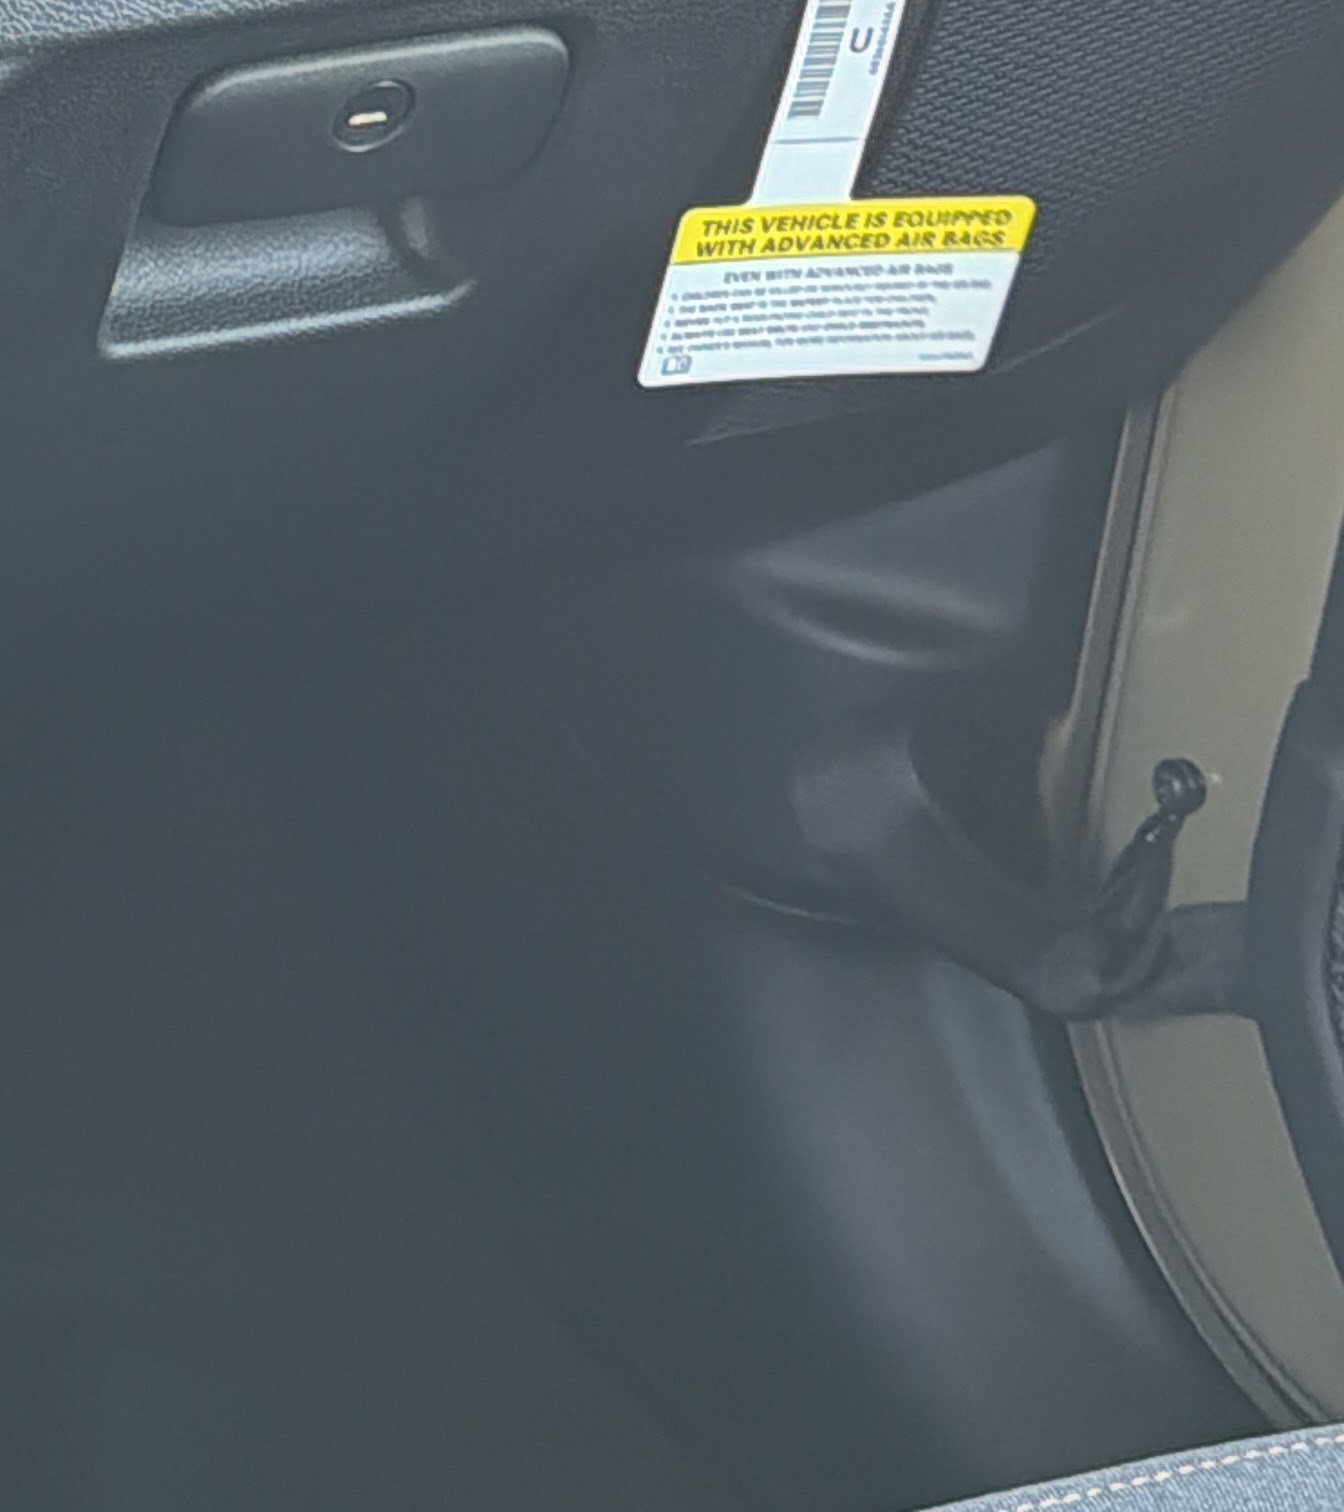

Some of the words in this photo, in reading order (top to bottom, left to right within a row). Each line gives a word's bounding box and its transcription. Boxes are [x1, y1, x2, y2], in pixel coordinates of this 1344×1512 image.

[702, 217, 756, 238] THIS
[761, 213, 859, 234] VEHICLE
[864, 211, 886, 229] IS
[892, 209, 1013, 229] EQUIPPED
[696, 237, 757, 258] WITH
[760, 232, 891, 254] ADVANCED
[896, 231, 937, 249] AIR
[941, 229, 1006, 248] BAGS
